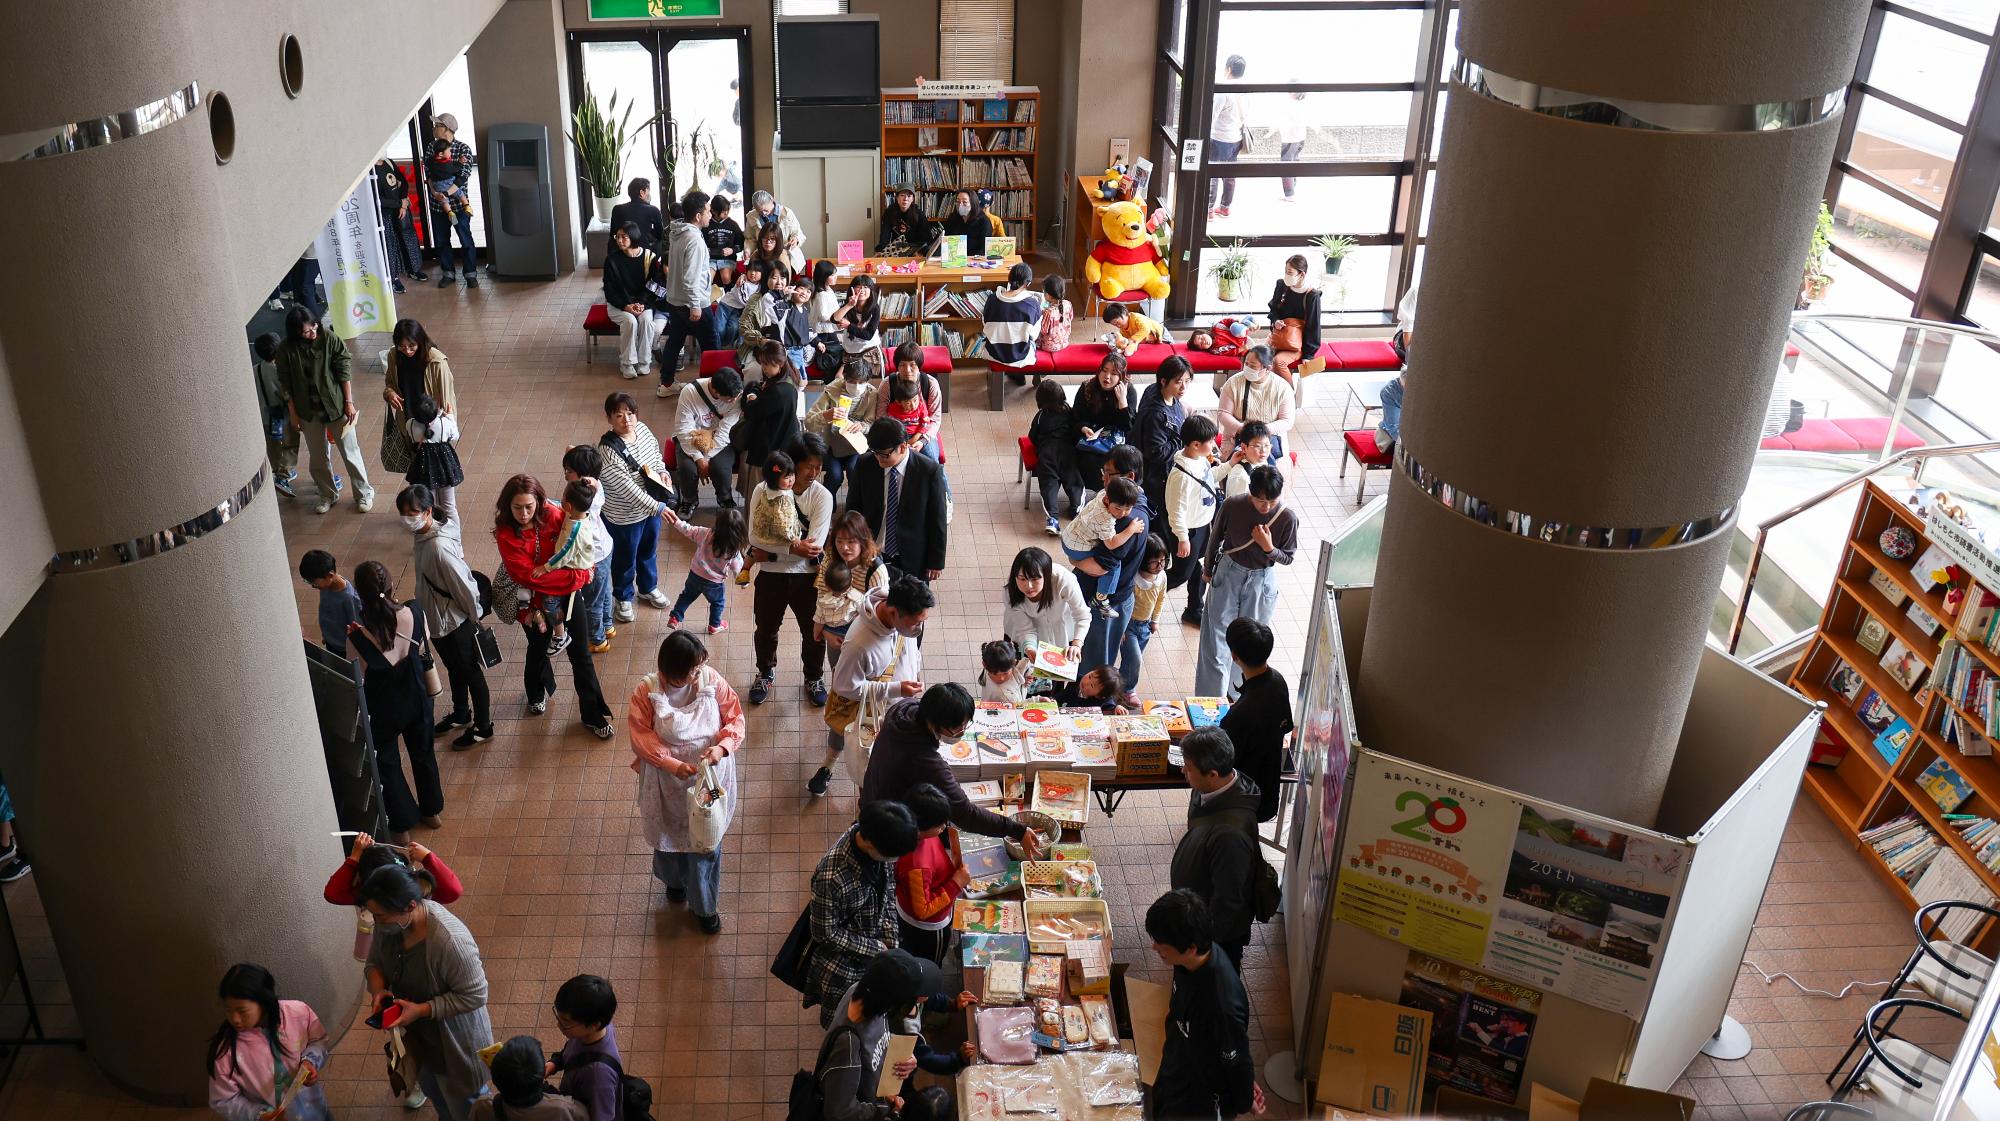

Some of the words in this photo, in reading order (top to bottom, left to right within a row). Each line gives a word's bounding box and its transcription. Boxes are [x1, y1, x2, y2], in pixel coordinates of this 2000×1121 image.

[1184, 142, 1197, 164] 禁煙
[1529, 859, 1576, 883] 20th
[1472, 1003, 1497, 1017] BEST
[1394, 1014, 1416, 1056] 日販
